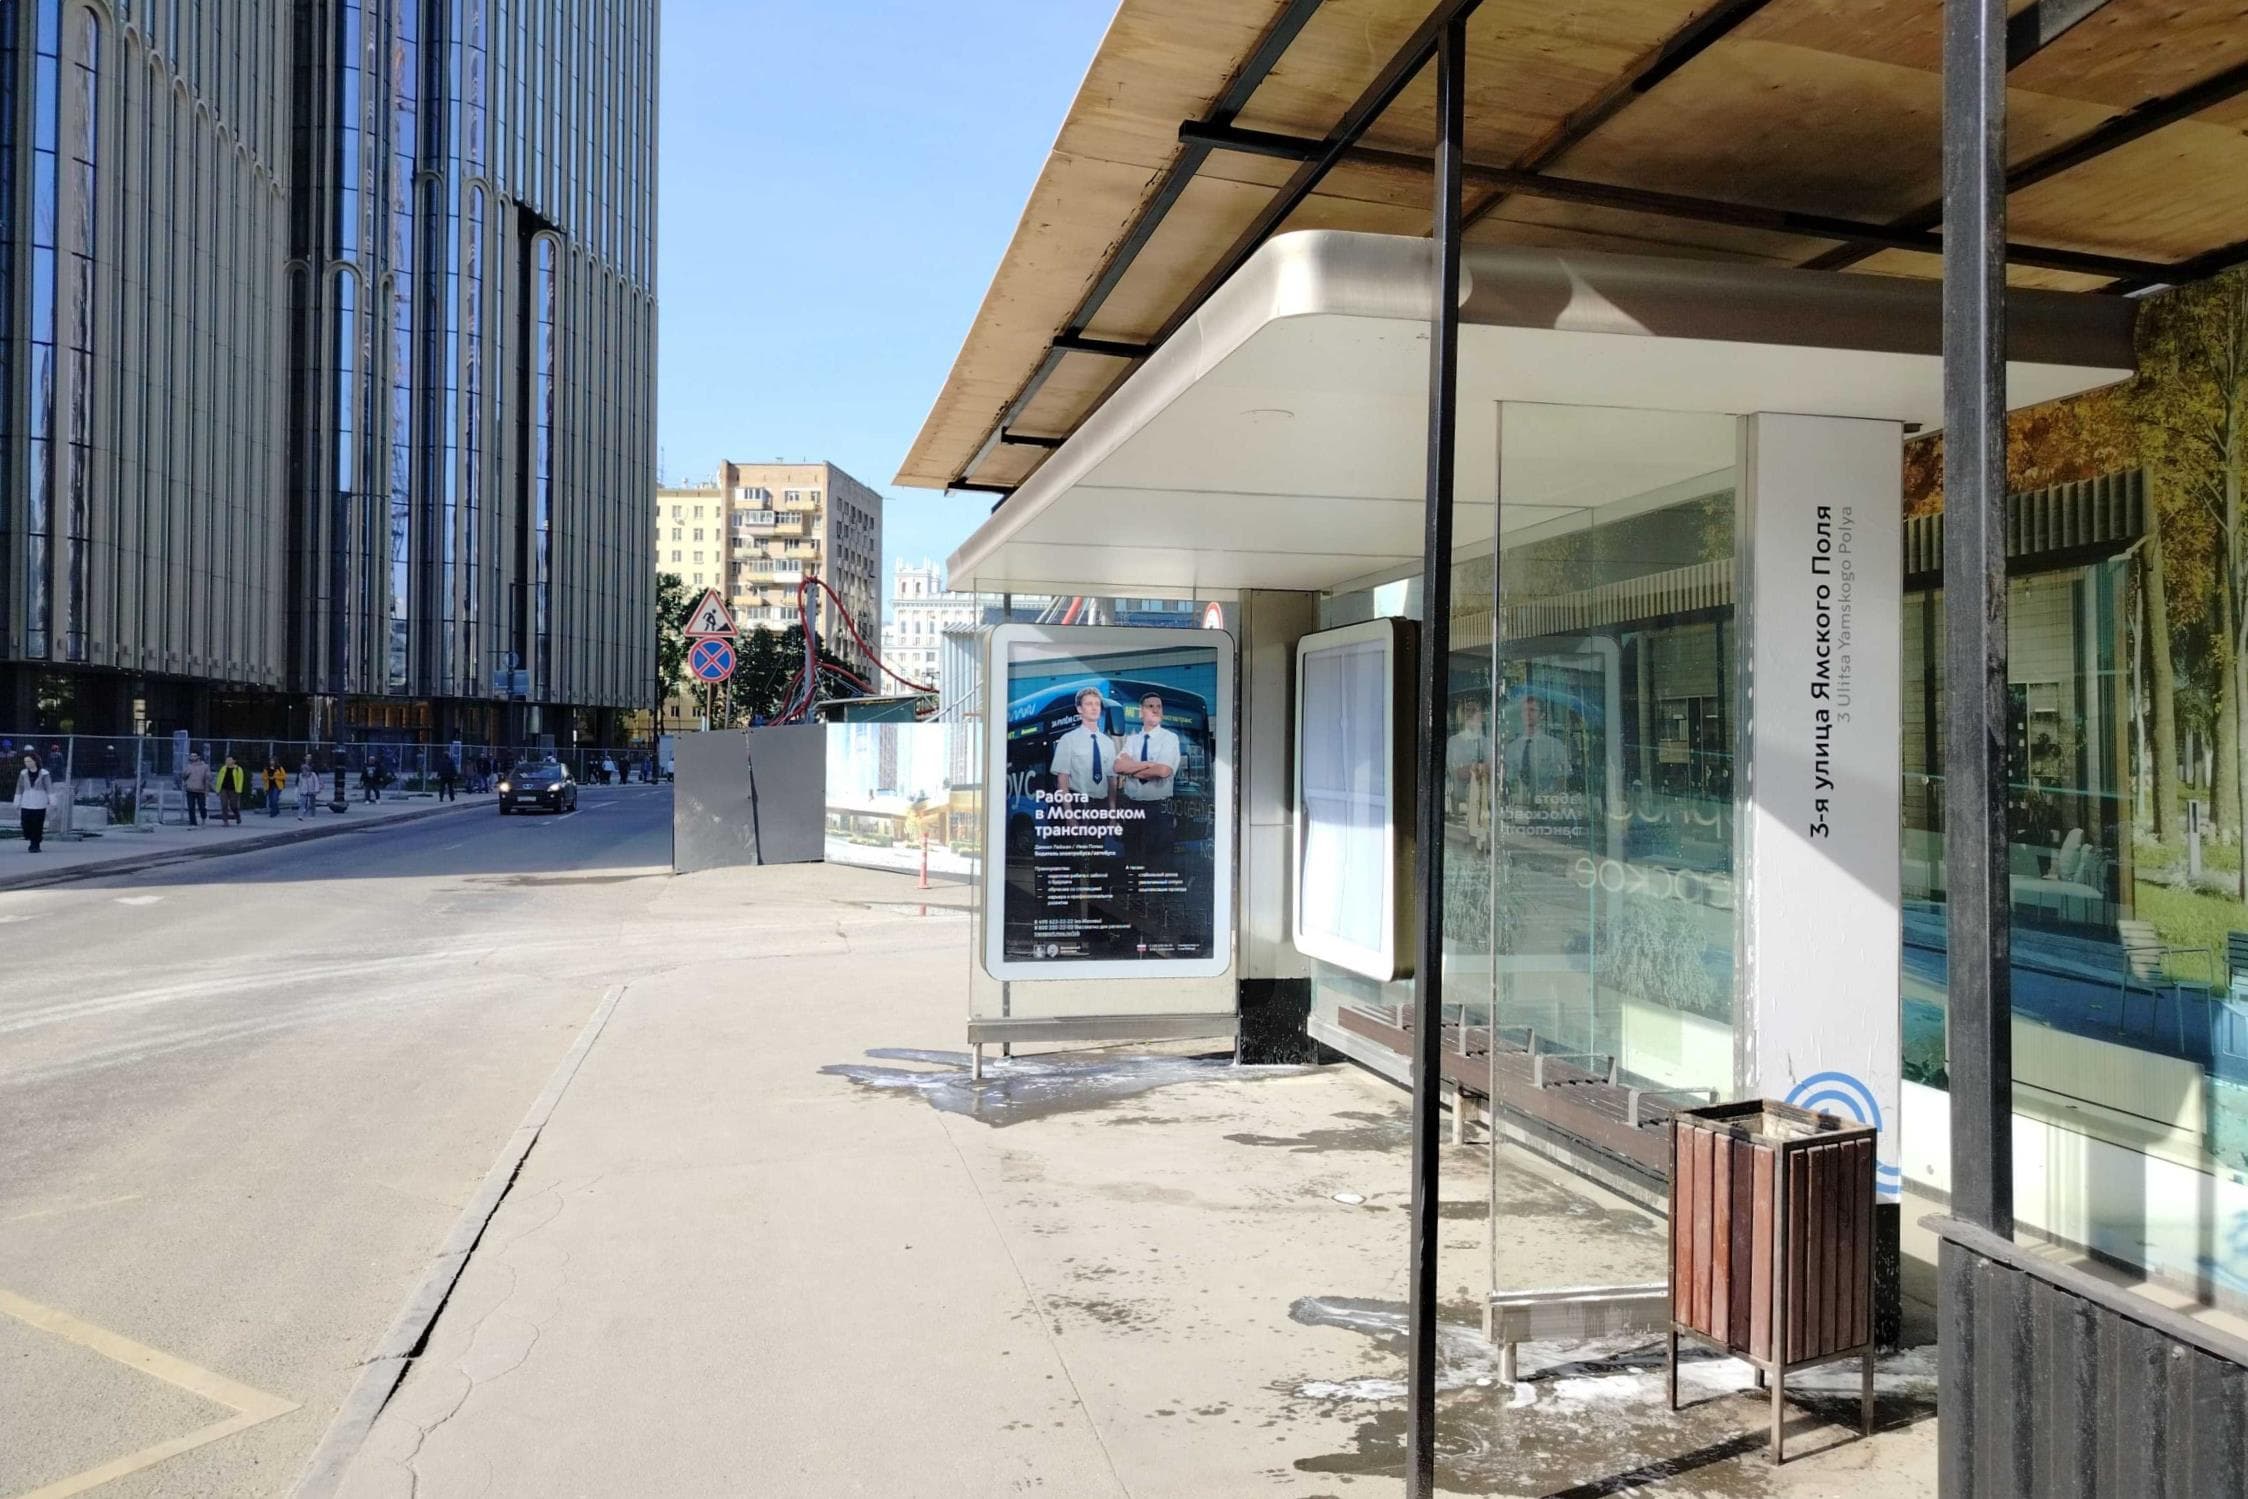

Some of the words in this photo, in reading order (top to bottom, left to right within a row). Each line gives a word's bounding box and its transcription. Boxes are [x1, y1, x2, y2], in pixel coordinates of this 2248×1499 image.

[1812, 505, 1831, 575] Поля
[1838, 506, 1853, 557] Polya
[1838, 561, 1855, 650] Yamskogo
[1811, 584, 1831, 700] Ямского
[1837, 652, 1851, 708] Ulitsa
[1837, 712, 1850, 723] 3
[1815, 709, 1835, 790] улица
[1035, 790, 1089, 804] Работа
[1035, 809, 1044, 820] в
[1047, 806, 1146, 820] Московском
[1810, 799, 1829, 839] 3-я
[1034, 825, 1124, 840] транспорте
